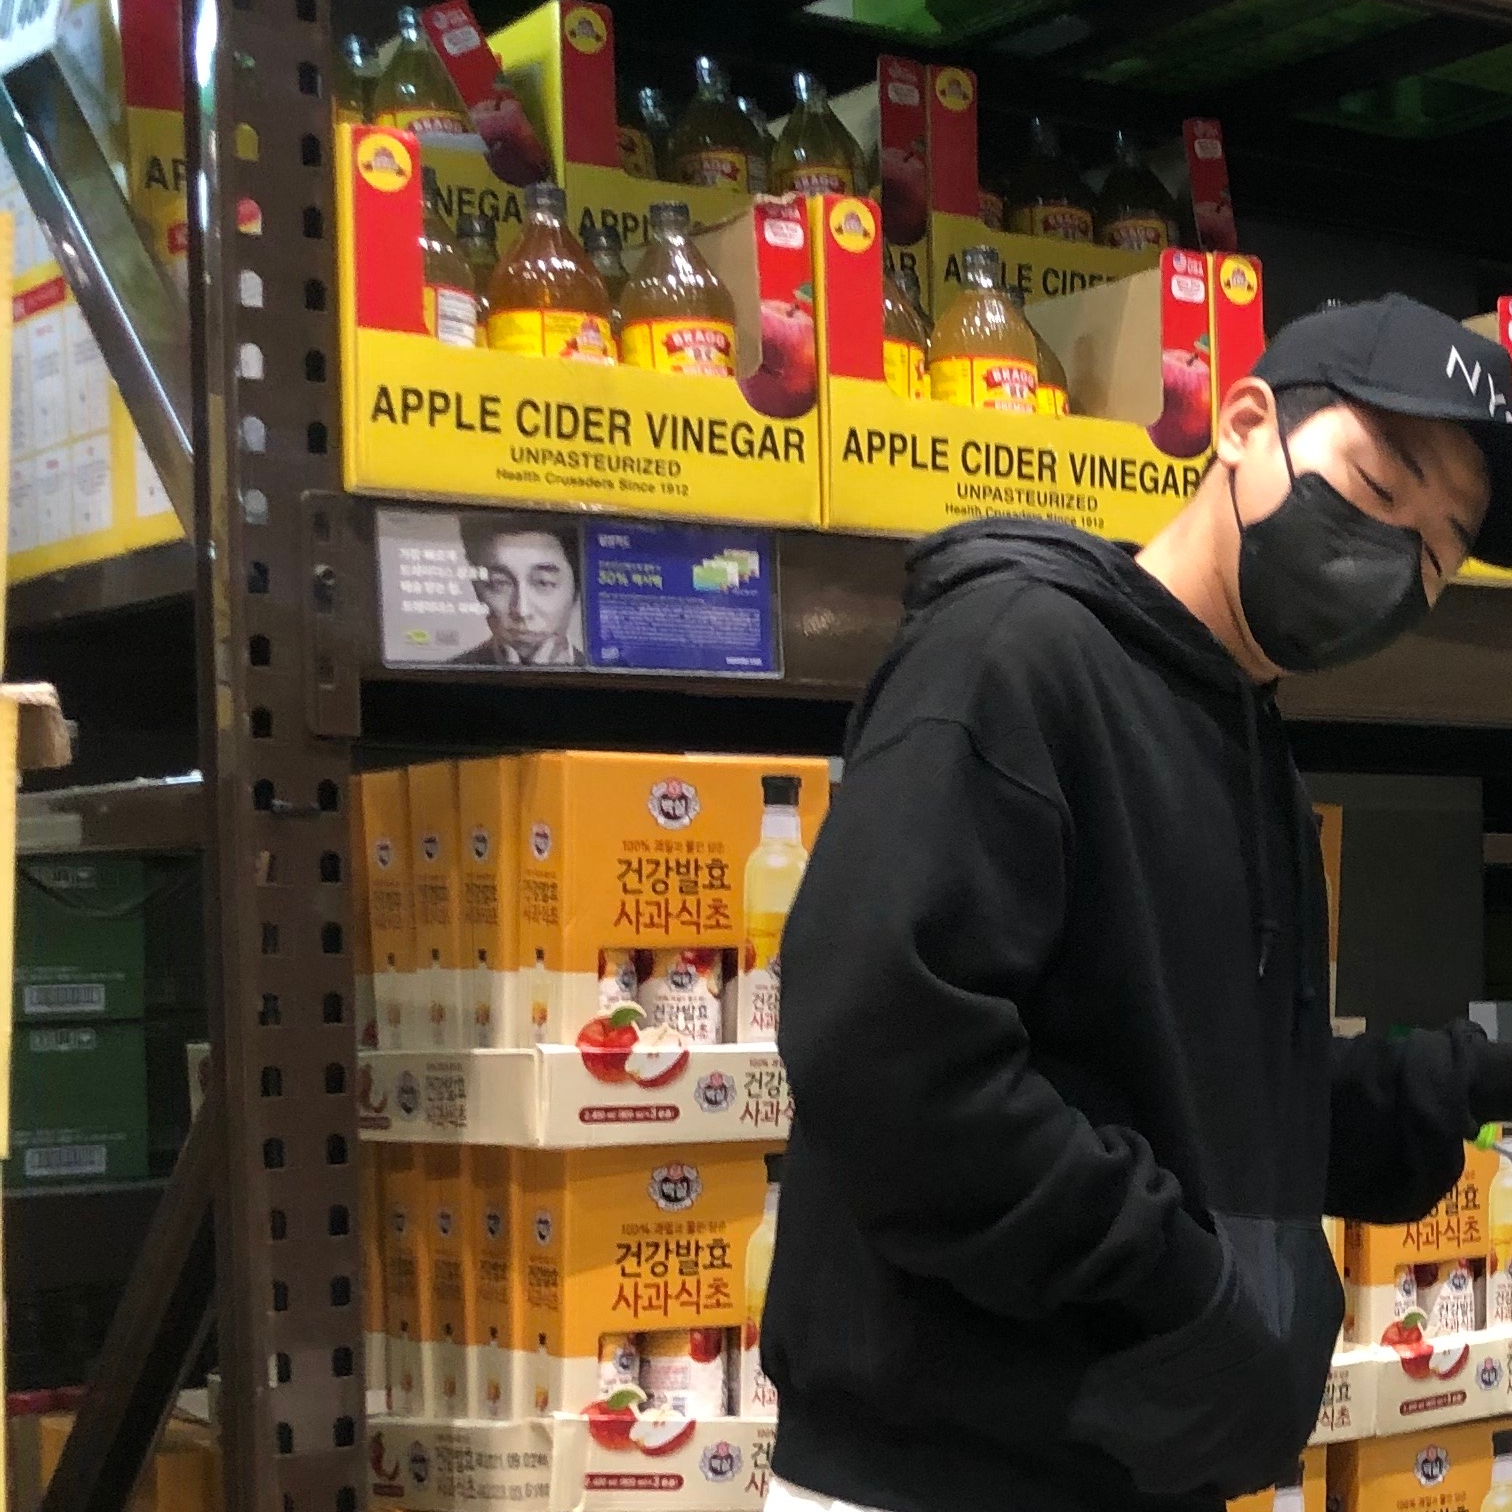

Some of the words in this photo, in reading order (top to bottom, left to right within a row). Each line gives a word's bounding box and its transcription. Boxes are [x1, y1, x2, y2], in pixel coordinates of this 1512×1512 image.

[430, 184, 523, 224] NEGA
[944, 253, 1033, 294] ALE
[370, 383, 501, 434] APPLE
[516, 398, 632, 447] CIDER
[646, 410, 807, 464] VINEGAR
[510, 445, 683, 479] UNPASTEURIZED
[842, 426, 950, 472] APPLE
[960, 439, 1057, 484] CIDER
[1068, 450, 1205, 500] VINEGAR
[496, 467, 541, 484] Health
[545, 472, 616, 491] Crusaders
[619, 477, 656, 494] Since
[660, 482, 689, 497] 1912
[956, 481, 1099, 512] UNPASTEURIZED
[945, 502, 982, 519] Health
[616, 857, 732, 895] 건강발효
[613, 897, 733, 935] 사과식초
[1427, 1183, 1481, 1216] 발효
[1402, 1215, 1482, 1252] 사과식초
[615, 1237, 733, 1278] 건강발효
[611, 1277, 734, 1318] 사과식초
